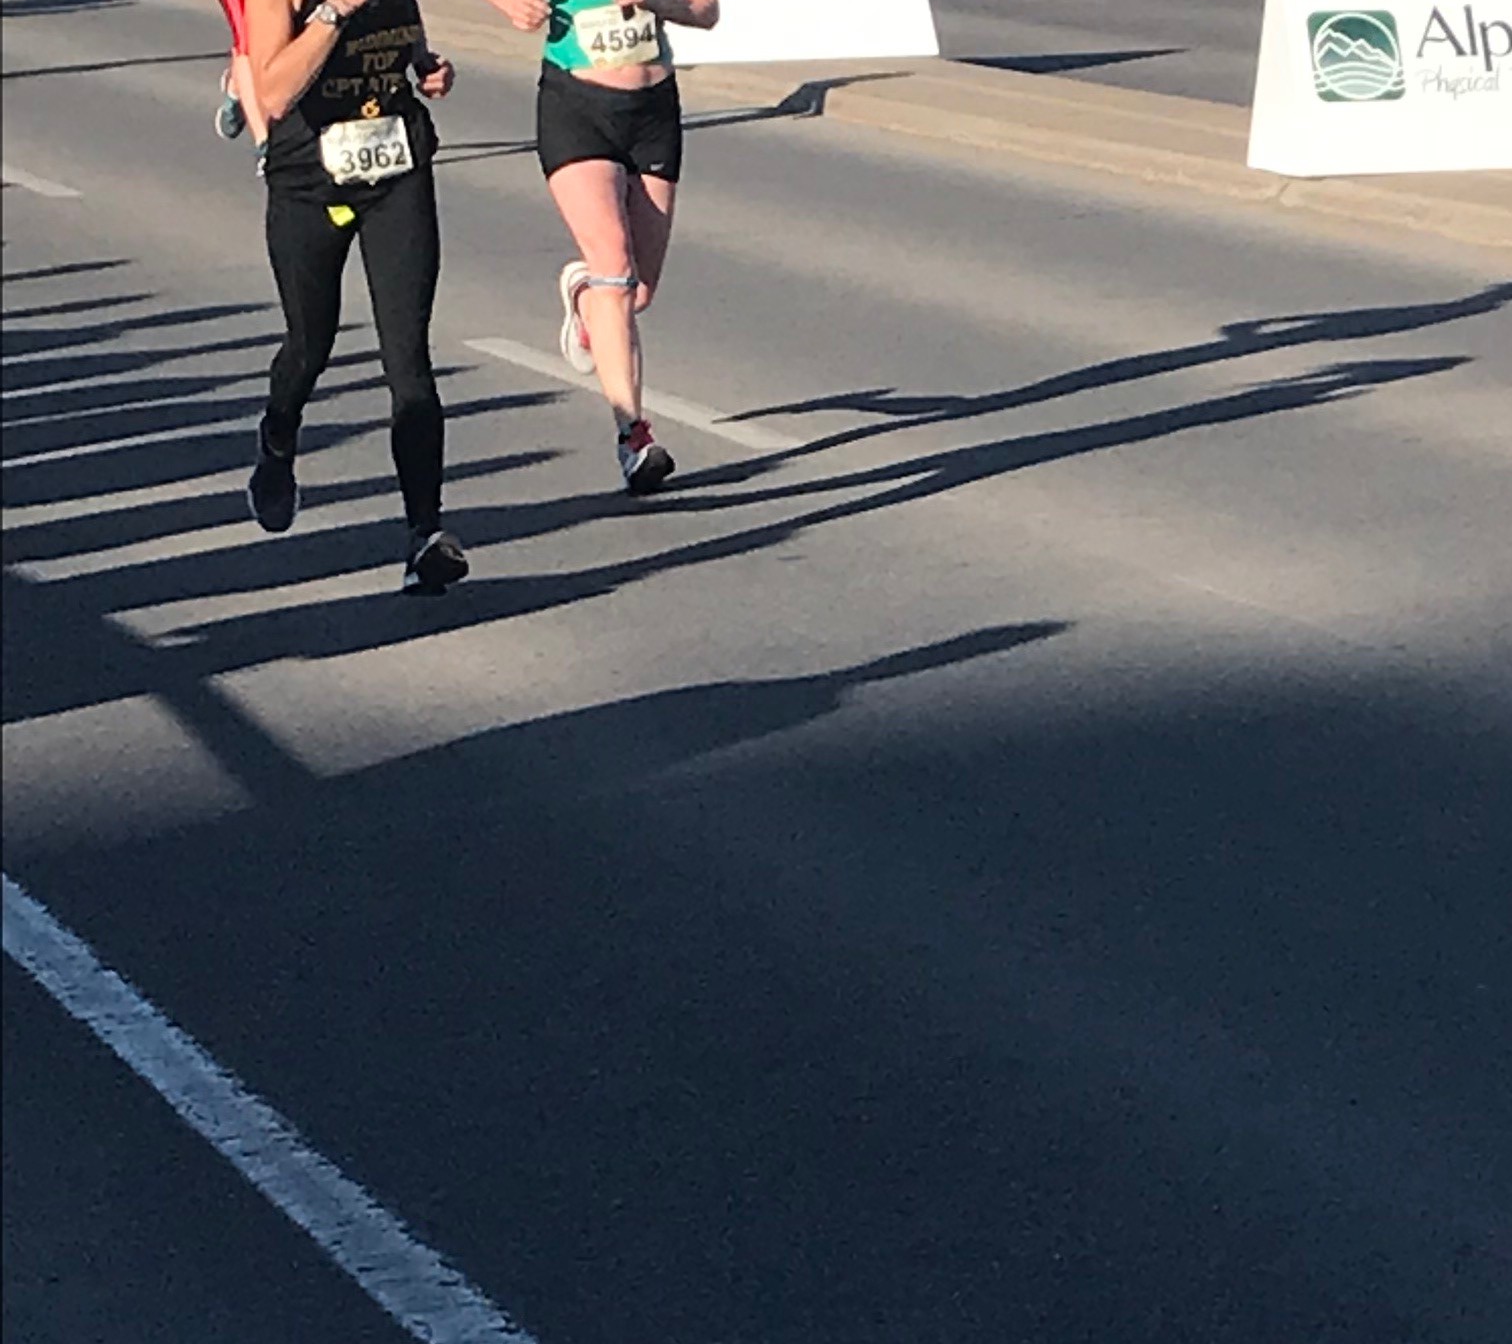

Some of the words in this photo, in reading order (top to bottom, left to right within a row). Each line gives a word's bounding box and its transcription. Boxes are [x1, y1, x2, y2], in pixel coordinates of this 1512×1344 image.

[591, 22, 654, 53] 4594
[1415, 64, 1500, 101] Physical
[340, 141, 407, 174] 3962
